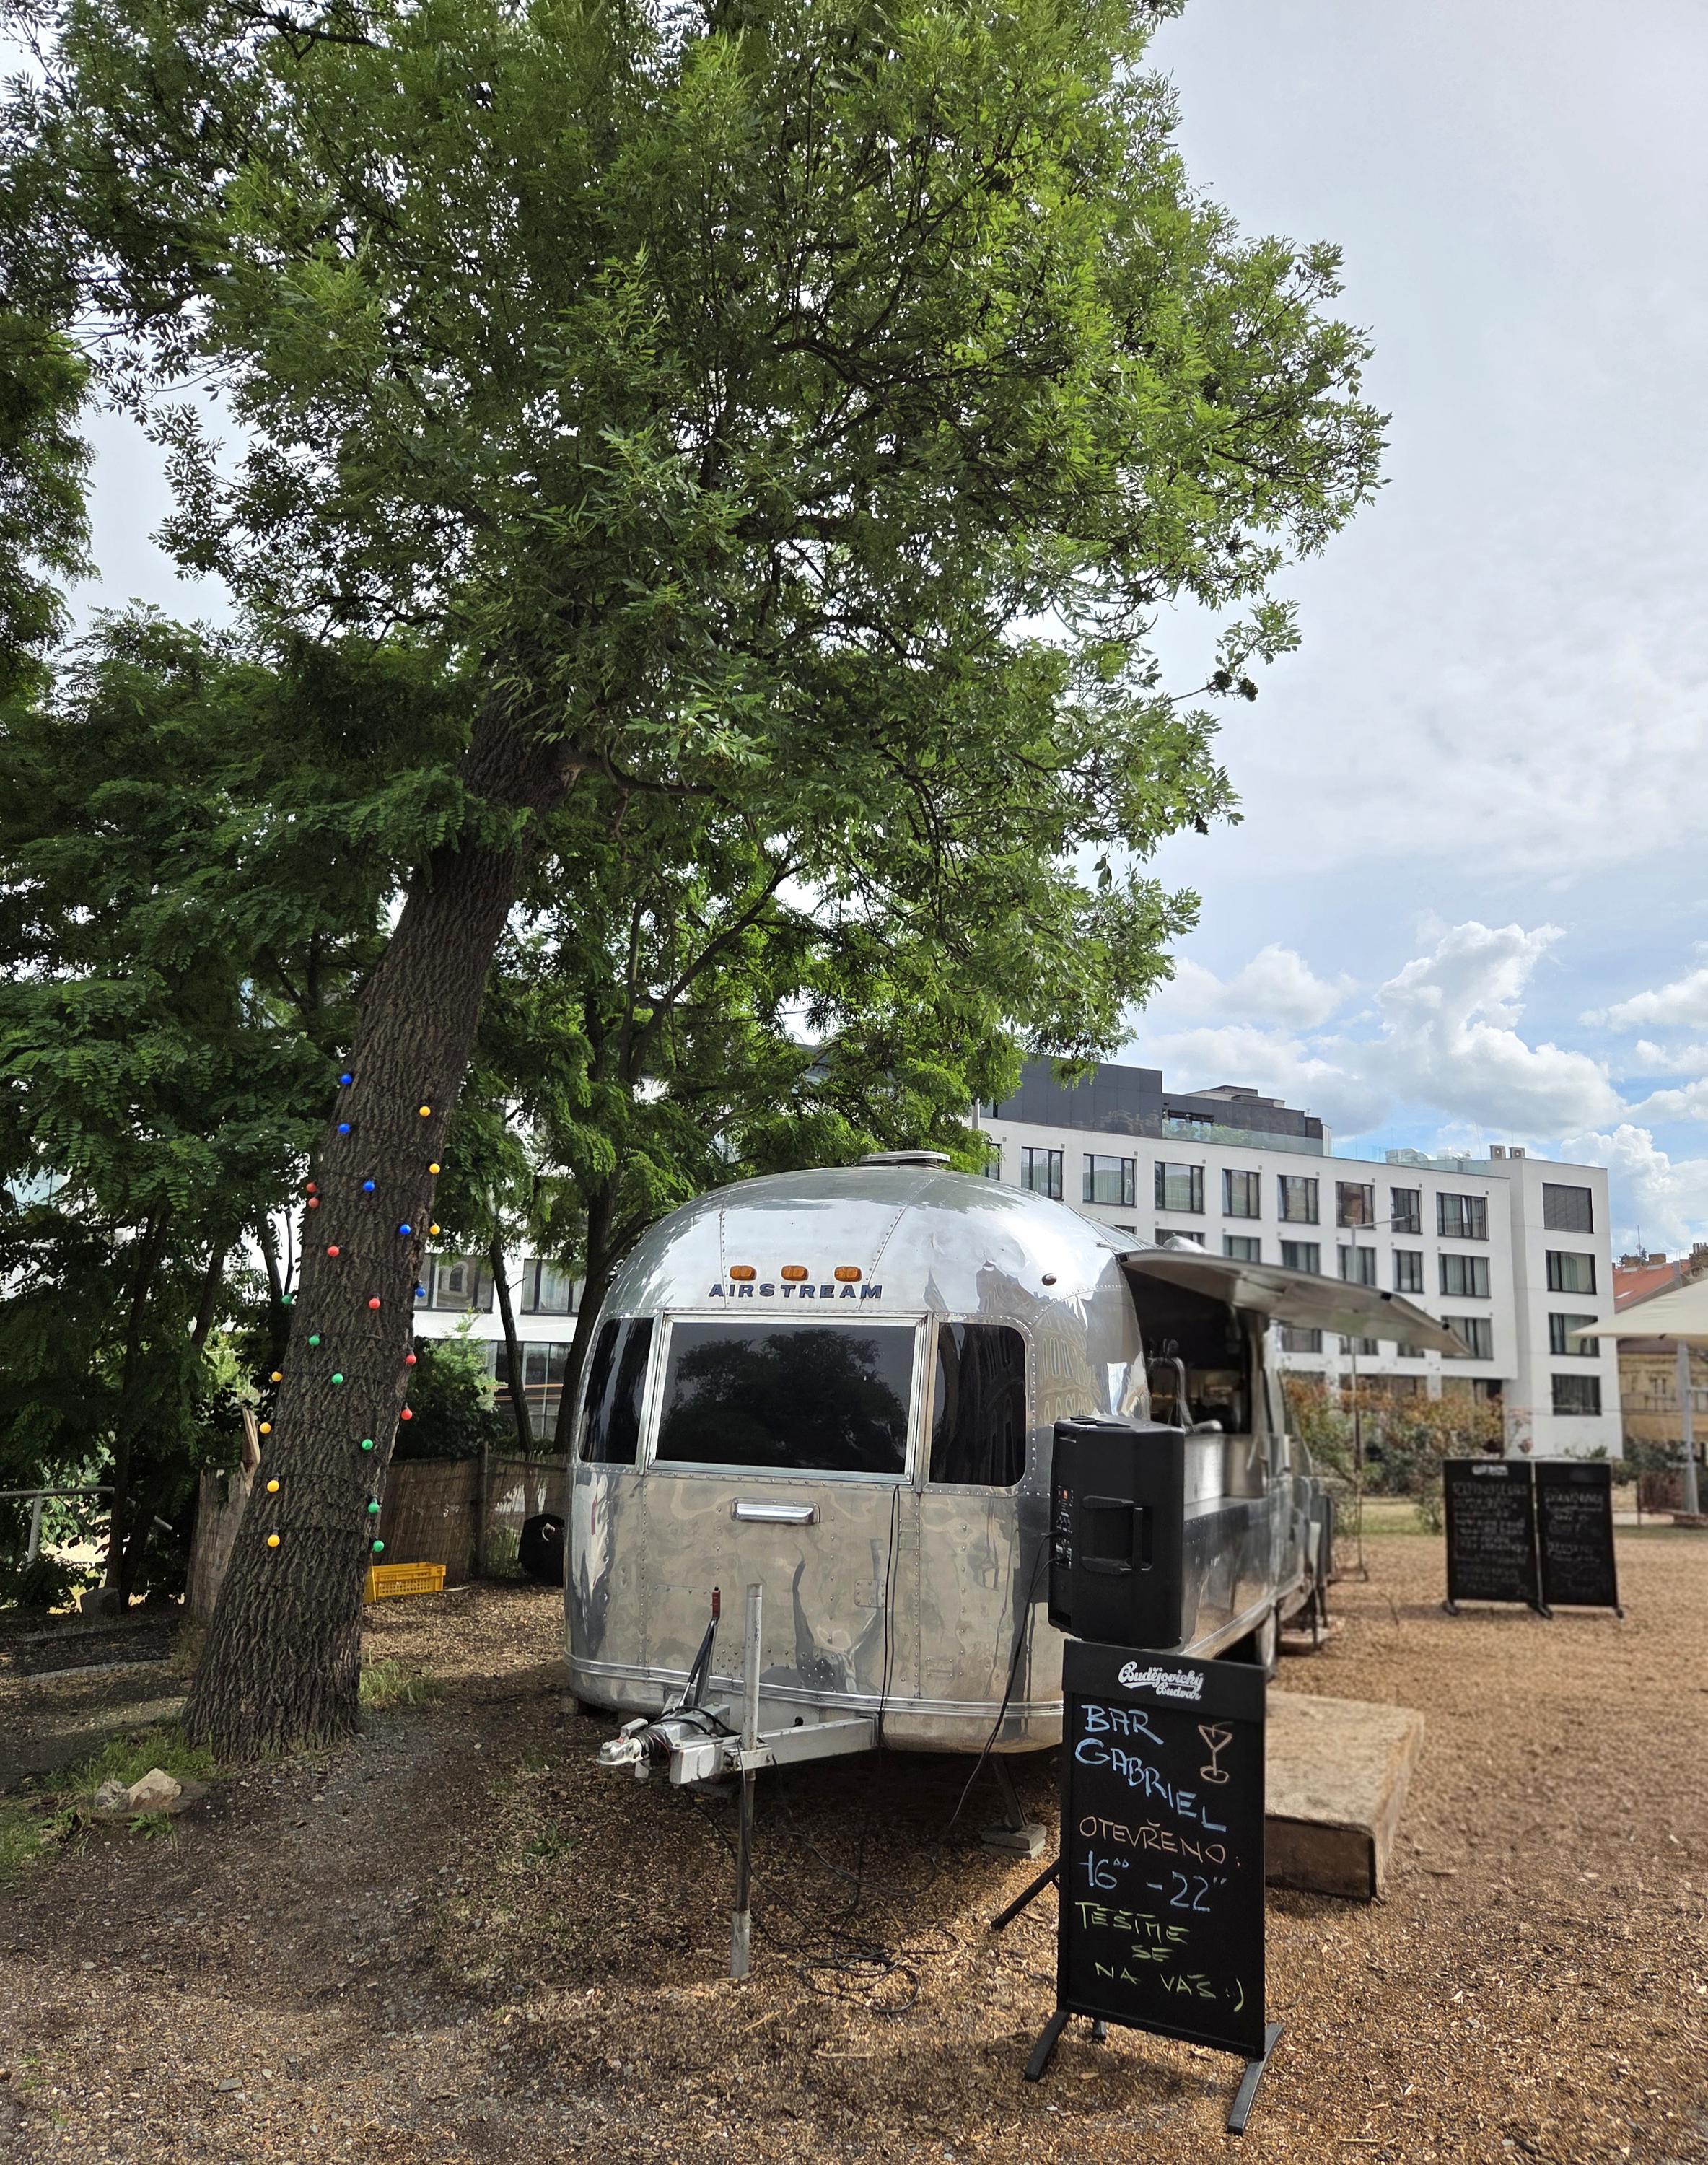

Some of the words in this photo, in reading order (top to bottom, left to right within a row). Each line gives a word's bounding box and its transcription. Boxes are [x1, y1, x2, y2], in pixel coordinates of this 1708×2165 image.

[709, 1283, 882, 1299] AIRSTREAM
[1118, 1661, 1204, 1691] Budějovický
[1156, 1682, 1201, 1700] Budvar
[1081, 1705, 1164, 1745] BAR
[1075, 1738, 1227, 1832] GABRIEL
[1131, 1945, 1173, 1961] SE
[1095, 1961, 1141, 1985] NA
